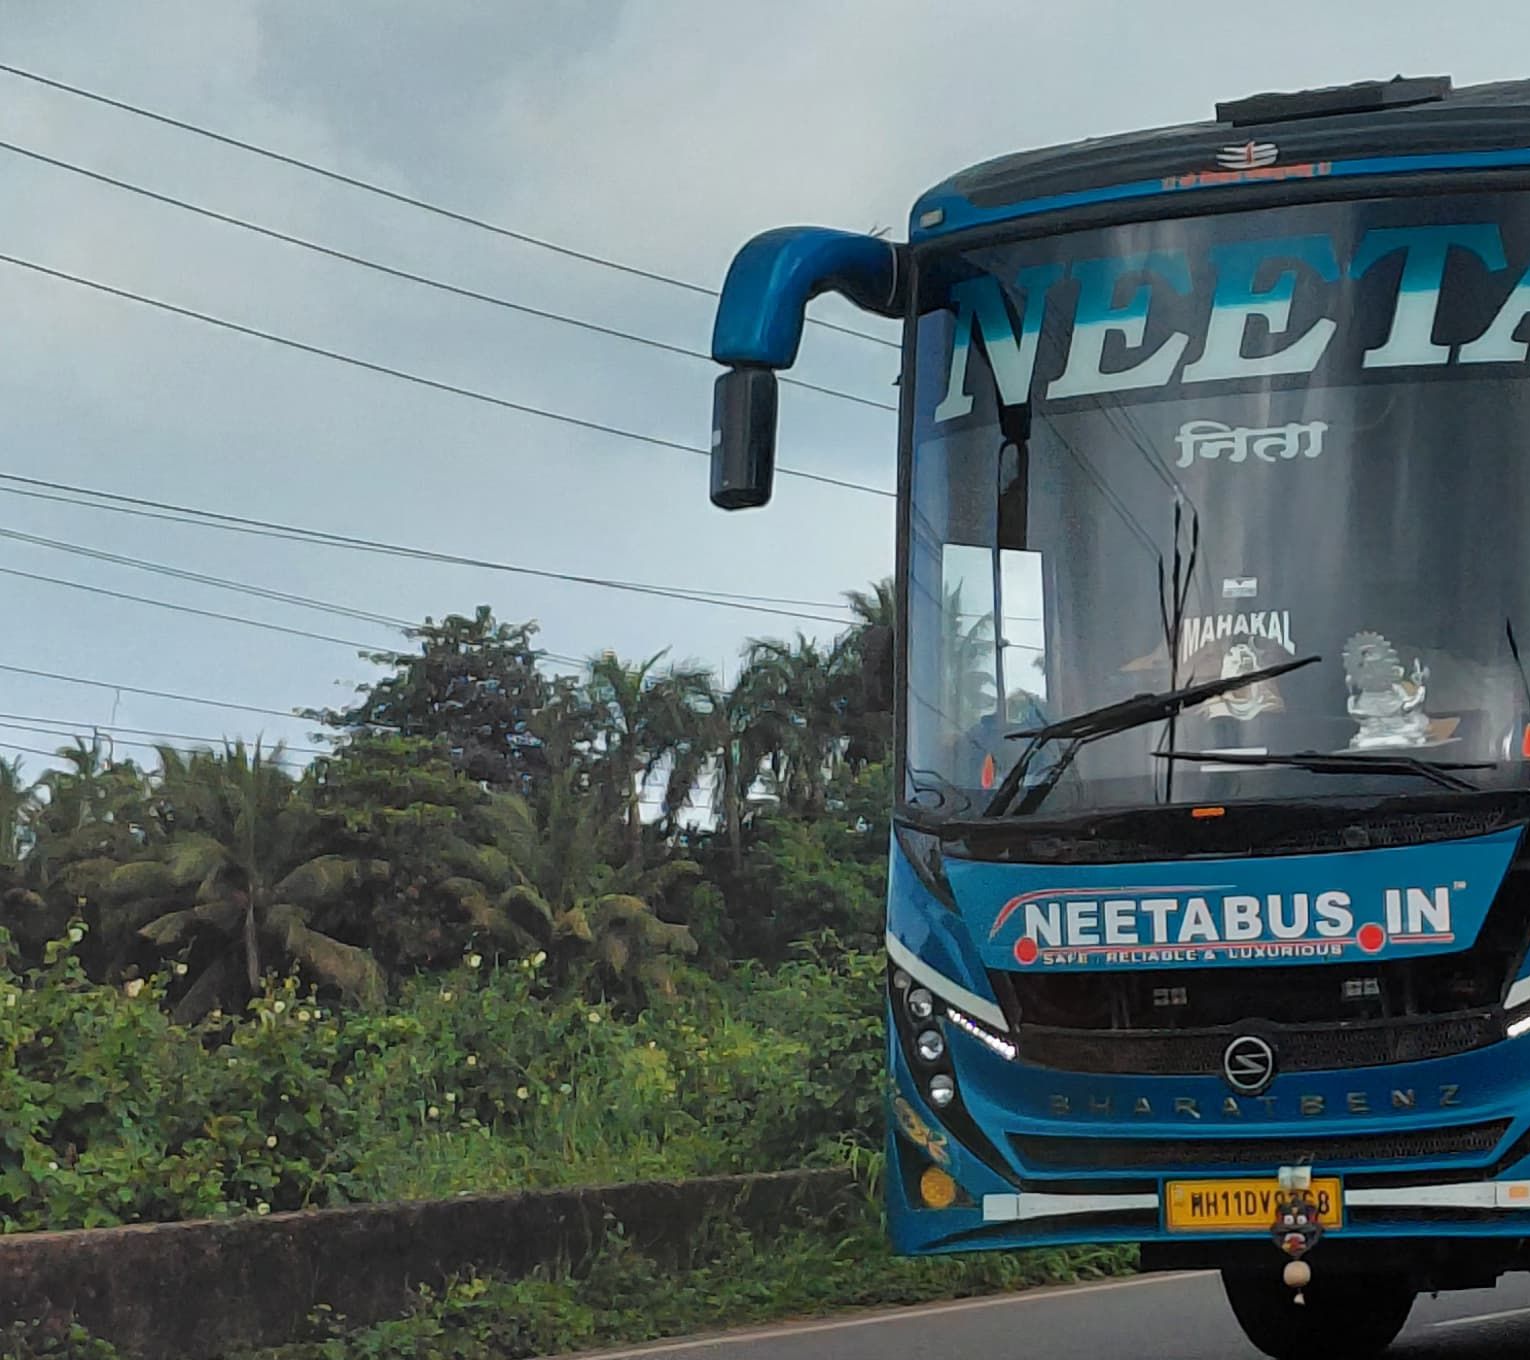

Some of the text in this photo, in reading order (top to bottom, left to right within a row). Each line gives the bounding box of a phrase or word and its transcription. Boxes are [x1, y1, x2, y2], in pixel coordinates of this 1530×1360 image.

[1174, 420, 1328, 468] निता
[1183, 610, 1295, 665] MAHAKAL
[1204, 948, 1216, 960] &
[1228, 944, 1342, 960] LUXURIOUS
[1048, 1084, 1461, 1119] BHARATBENZ
